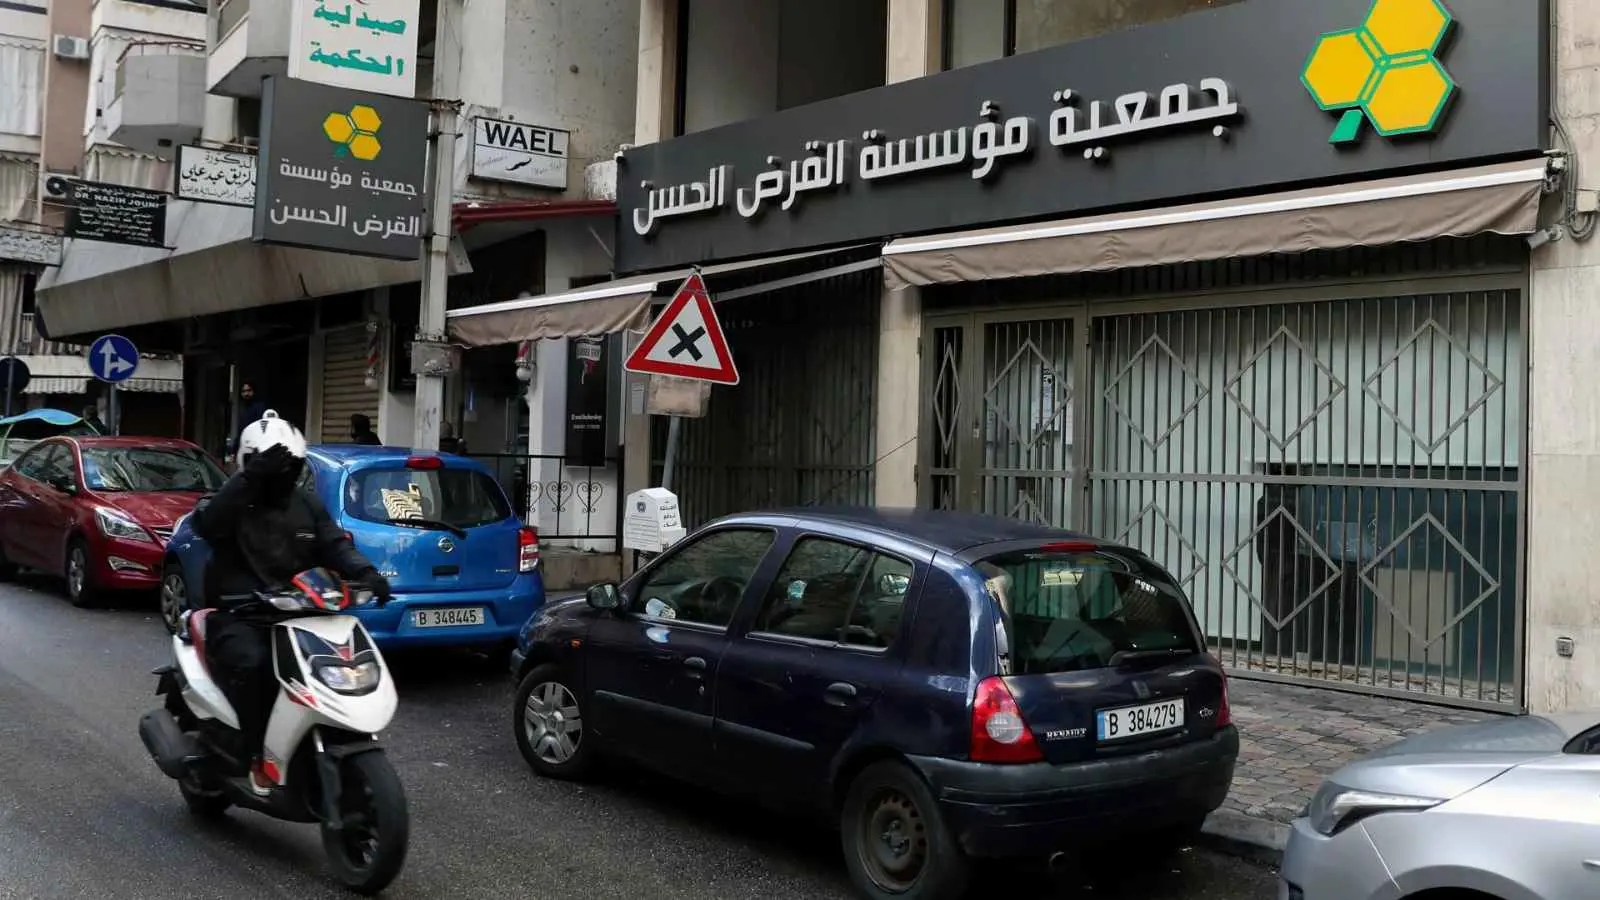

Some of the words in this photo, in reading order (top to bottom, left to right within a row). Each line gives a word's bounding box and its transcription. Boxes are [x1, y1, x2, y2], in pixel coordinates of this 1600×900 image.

[314, 0, 406, 34] صيدلية
[310, 41, 405, 76] الحكمة
[1049, 75, 1238, 159] جمعية
[484, 121, 563, 155] WAEL
[860, 100, 1030, 180] مؤسسة
[280, 158, 352, 189] مؤسسة
[361, 171, 417, 200] جمعية
[736, 139, 846, 219] القرض
[270, 198, 347, 227] الحسن
[633, 164, 726, 237] الحسن
[353, 214, 420, 239] القرض
[419, 612, 427, 626] B
[434, 609, 478, 625] 348445
[1109, 713, 1119, 736] B
[1128, 703, 1177, 733] 384279
